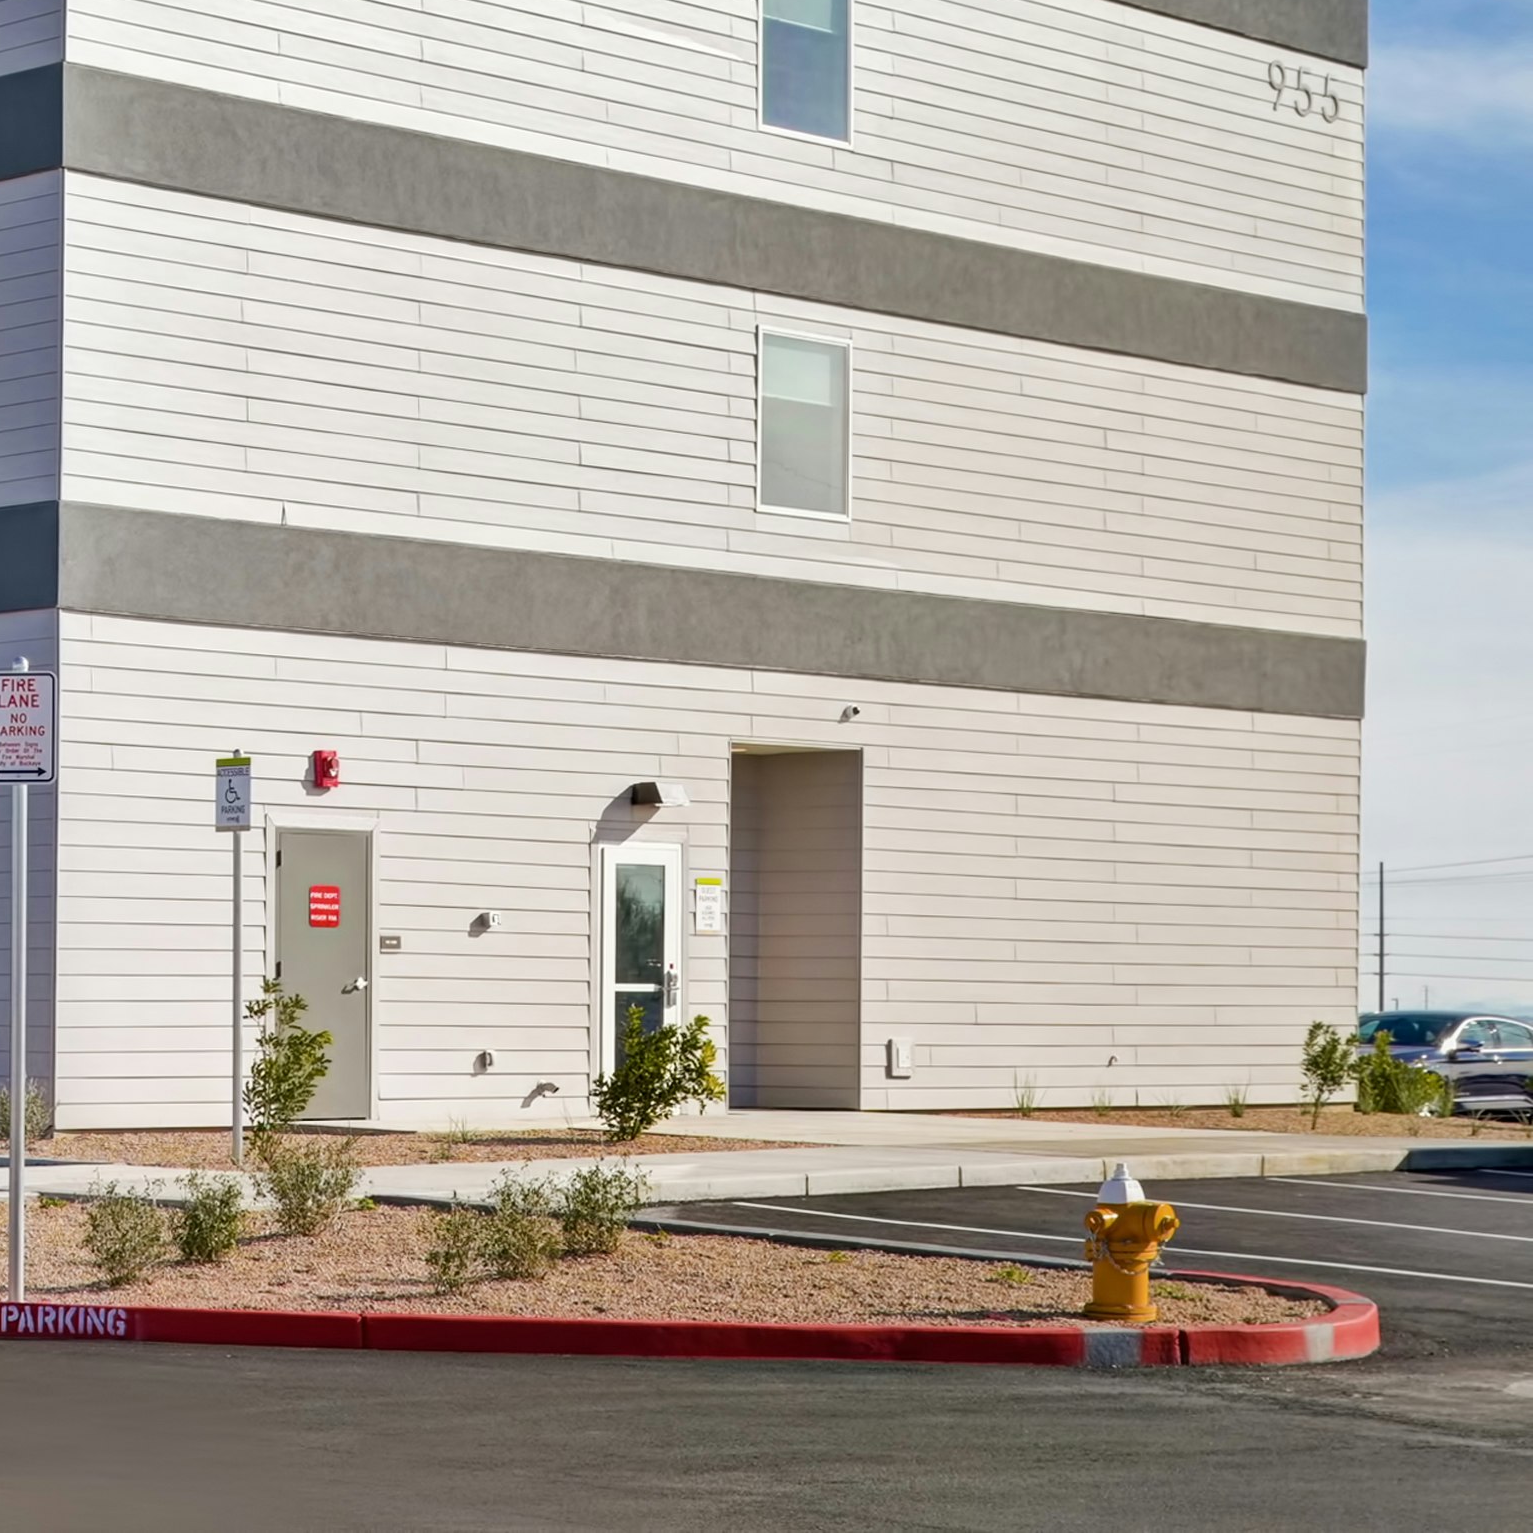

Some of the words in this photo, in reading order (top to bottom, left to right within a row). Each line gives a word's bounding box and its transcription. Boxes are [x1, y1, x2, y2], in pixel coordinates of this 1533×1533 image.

[1268, 60, 1339, 124] 955
[1, 678, 36, 692] FIRE
[10, 713, 27, 724] NO
[221, 805, 245, 814] PARKING
[0, 1304, 127, 1336] PARKING
